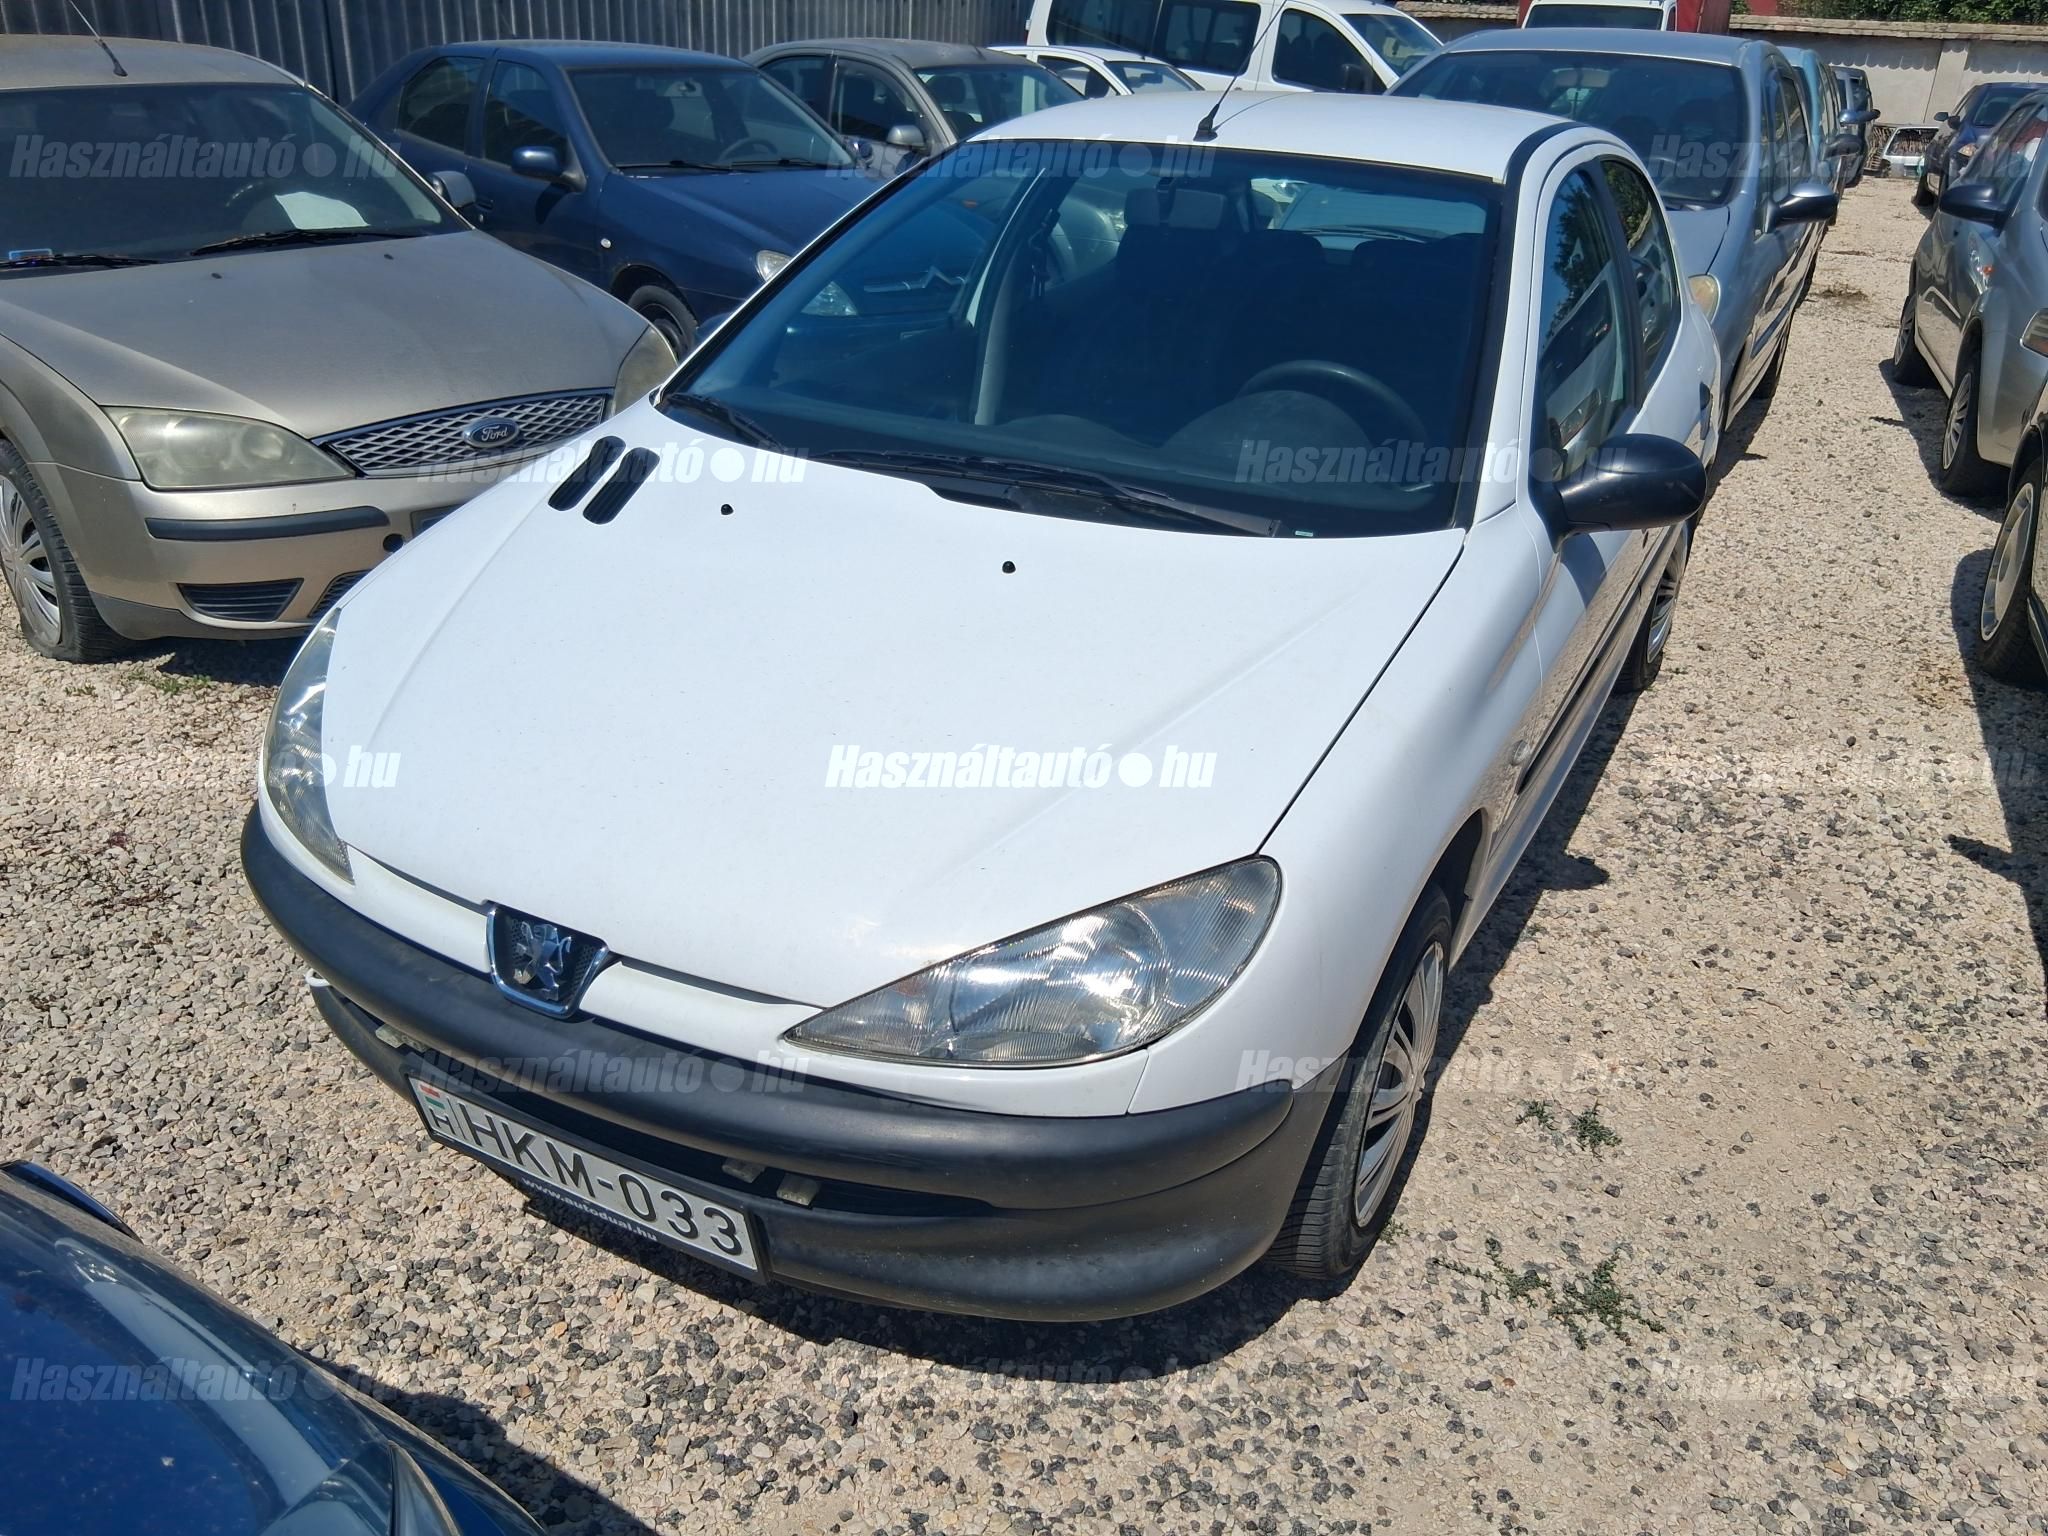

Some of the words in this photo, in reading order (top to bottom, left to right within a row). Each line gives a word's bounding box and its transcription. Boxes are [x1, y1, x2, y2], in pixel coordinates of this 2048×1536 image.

[481, 425, 508, 441] Ford
[429, 1107, 456, 1136] H
[457, 1102, 743, 1256] HKM-033
[521, 1176, 659, 1243] www.autodual.hu
